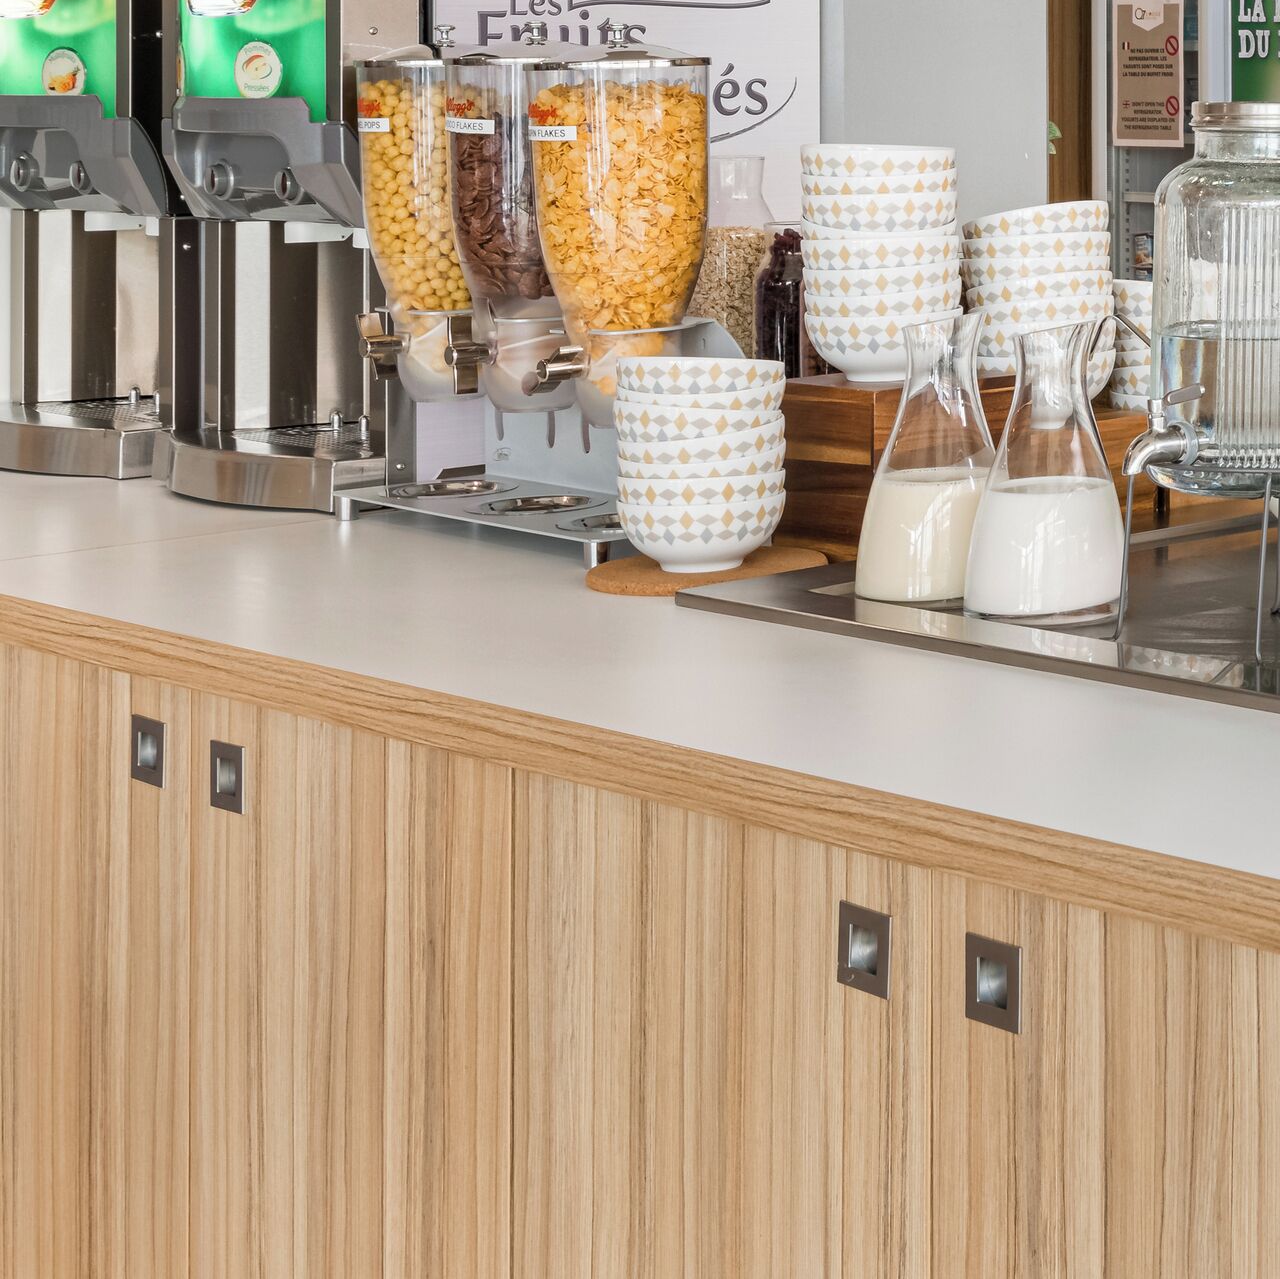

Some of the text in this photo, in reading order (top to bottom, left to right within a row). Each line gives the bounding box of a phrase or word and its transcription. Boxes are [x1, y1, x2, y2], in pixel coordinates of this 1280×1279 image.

[1238, 29, 1270, 59] DU
[365, 121, 380, 129] POPS
[457, 121, 484, 130] FLAKES
[538, 128, 566, 137] FLAKES
